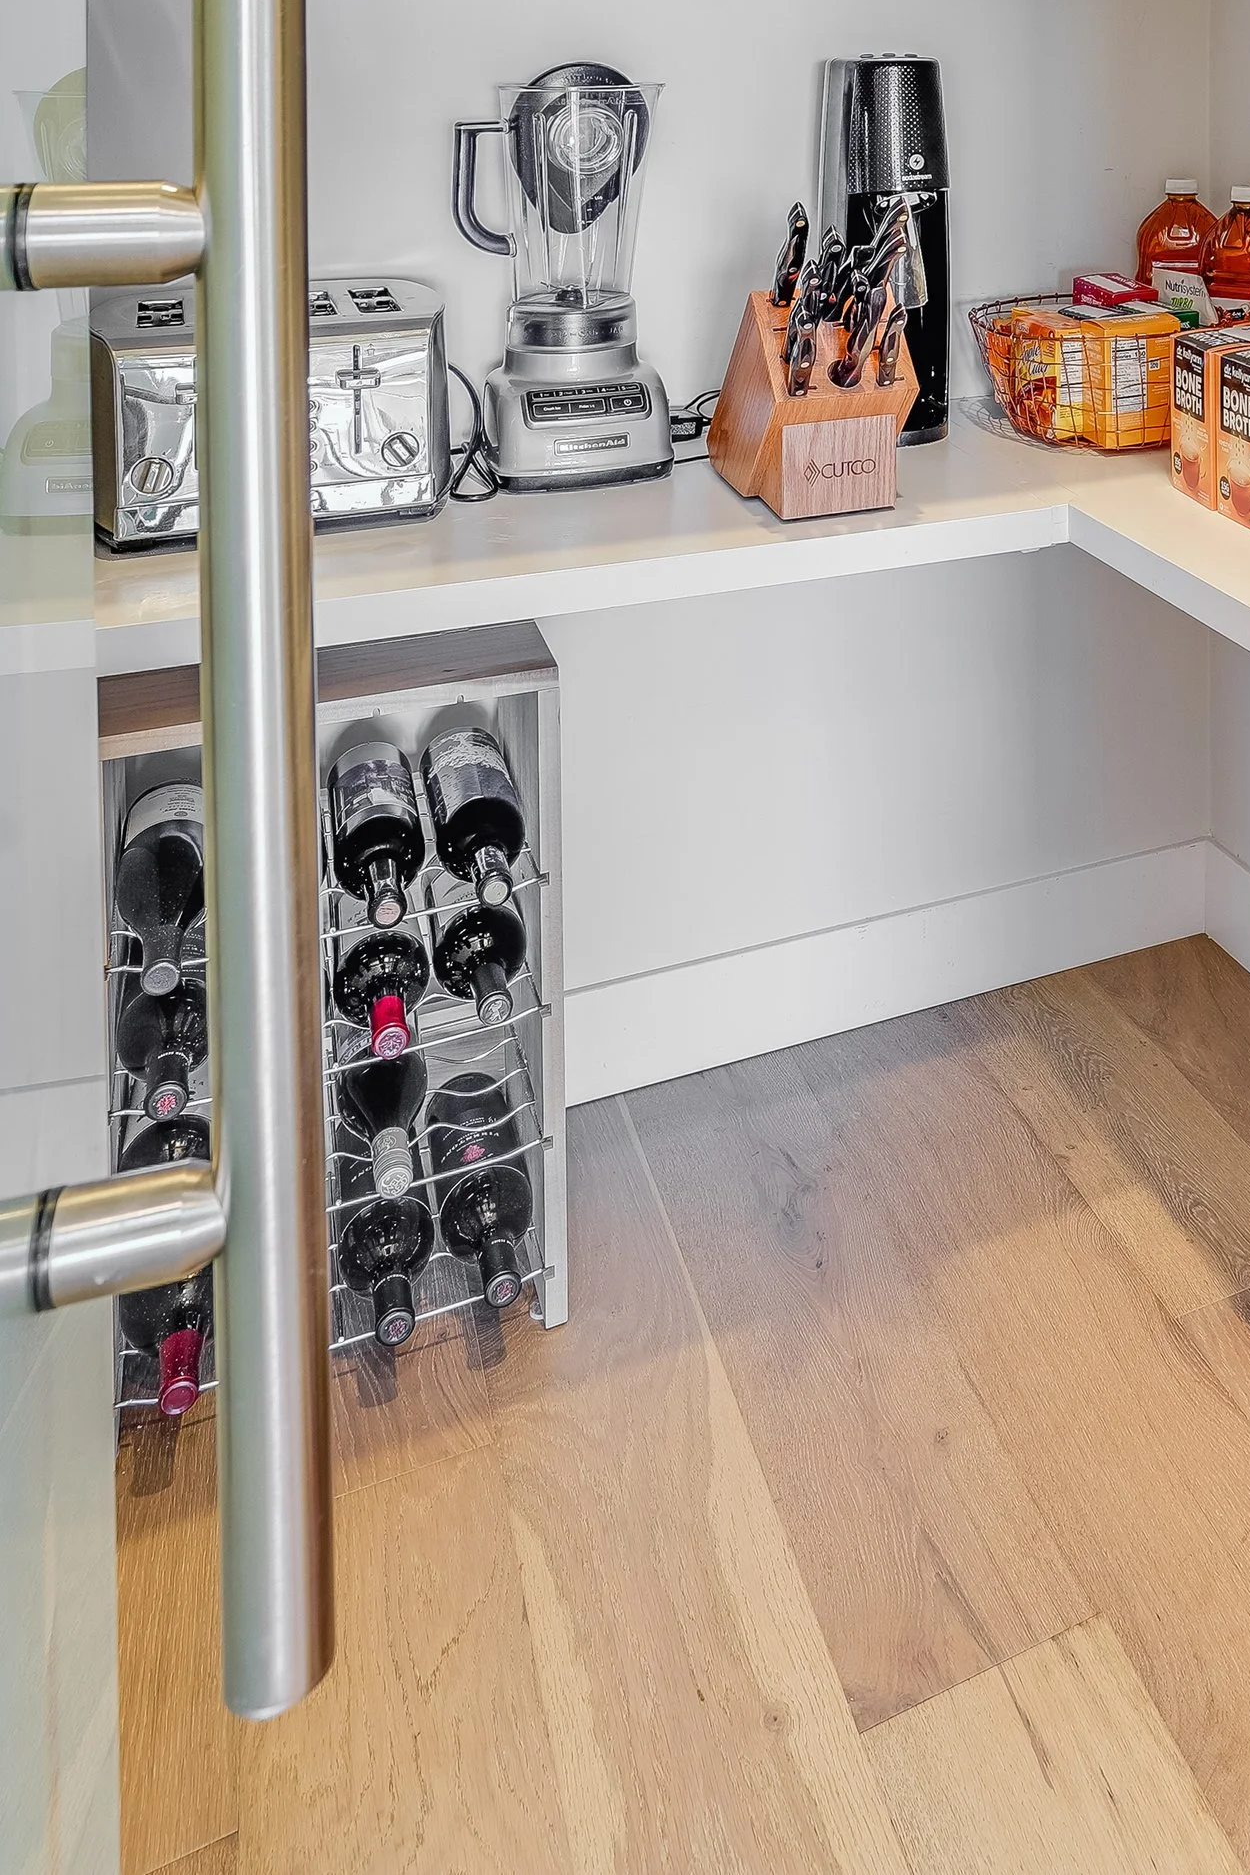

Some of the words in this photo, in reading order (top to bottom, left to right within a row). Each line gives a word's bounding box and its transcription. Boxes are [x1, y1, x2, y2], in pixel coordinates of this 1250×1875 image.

[1165, 280, 1206, 299] Nutrisystem
[1175, 367, 1202, 398] BONE
[1175, 388, 1202, 416] BROTH
[559, 438, 626, 452] KitchenAid
[820, 458, 877, 479] CUTCO
